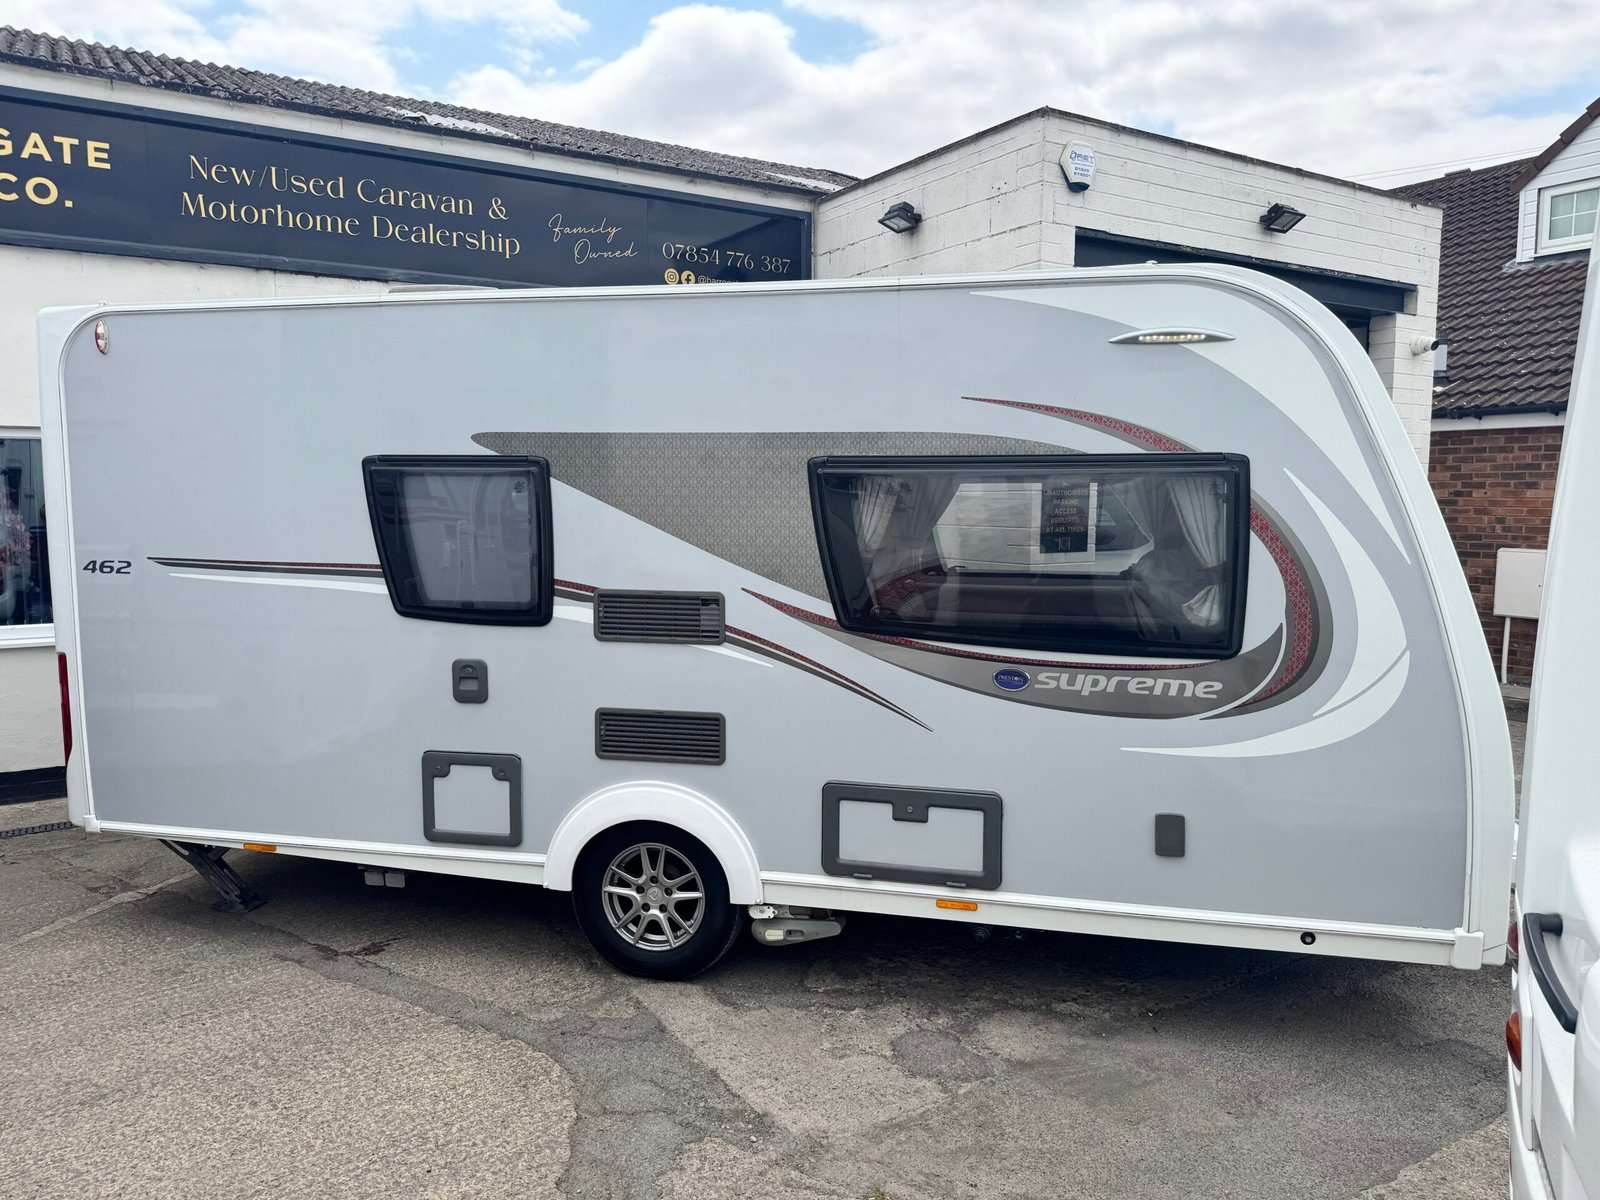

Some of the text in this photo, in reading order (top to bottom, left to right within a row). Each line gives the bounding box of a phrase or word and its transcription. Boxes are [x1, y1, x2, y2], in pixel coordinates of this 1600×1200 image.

[0, 172, 73, 208] CO.
[189, 154, 510, 221] New/Used Caravan &
[181, 191, 521, 259] Motorhome Dealership
[548, 213, 622, 243] Family
[574, 239, 639, 264] Owned
[662, 242, 791, 274] 07854 776 387
[83, 560, 132, 574] 462
[1034, 672, 1223, 699] supreme
